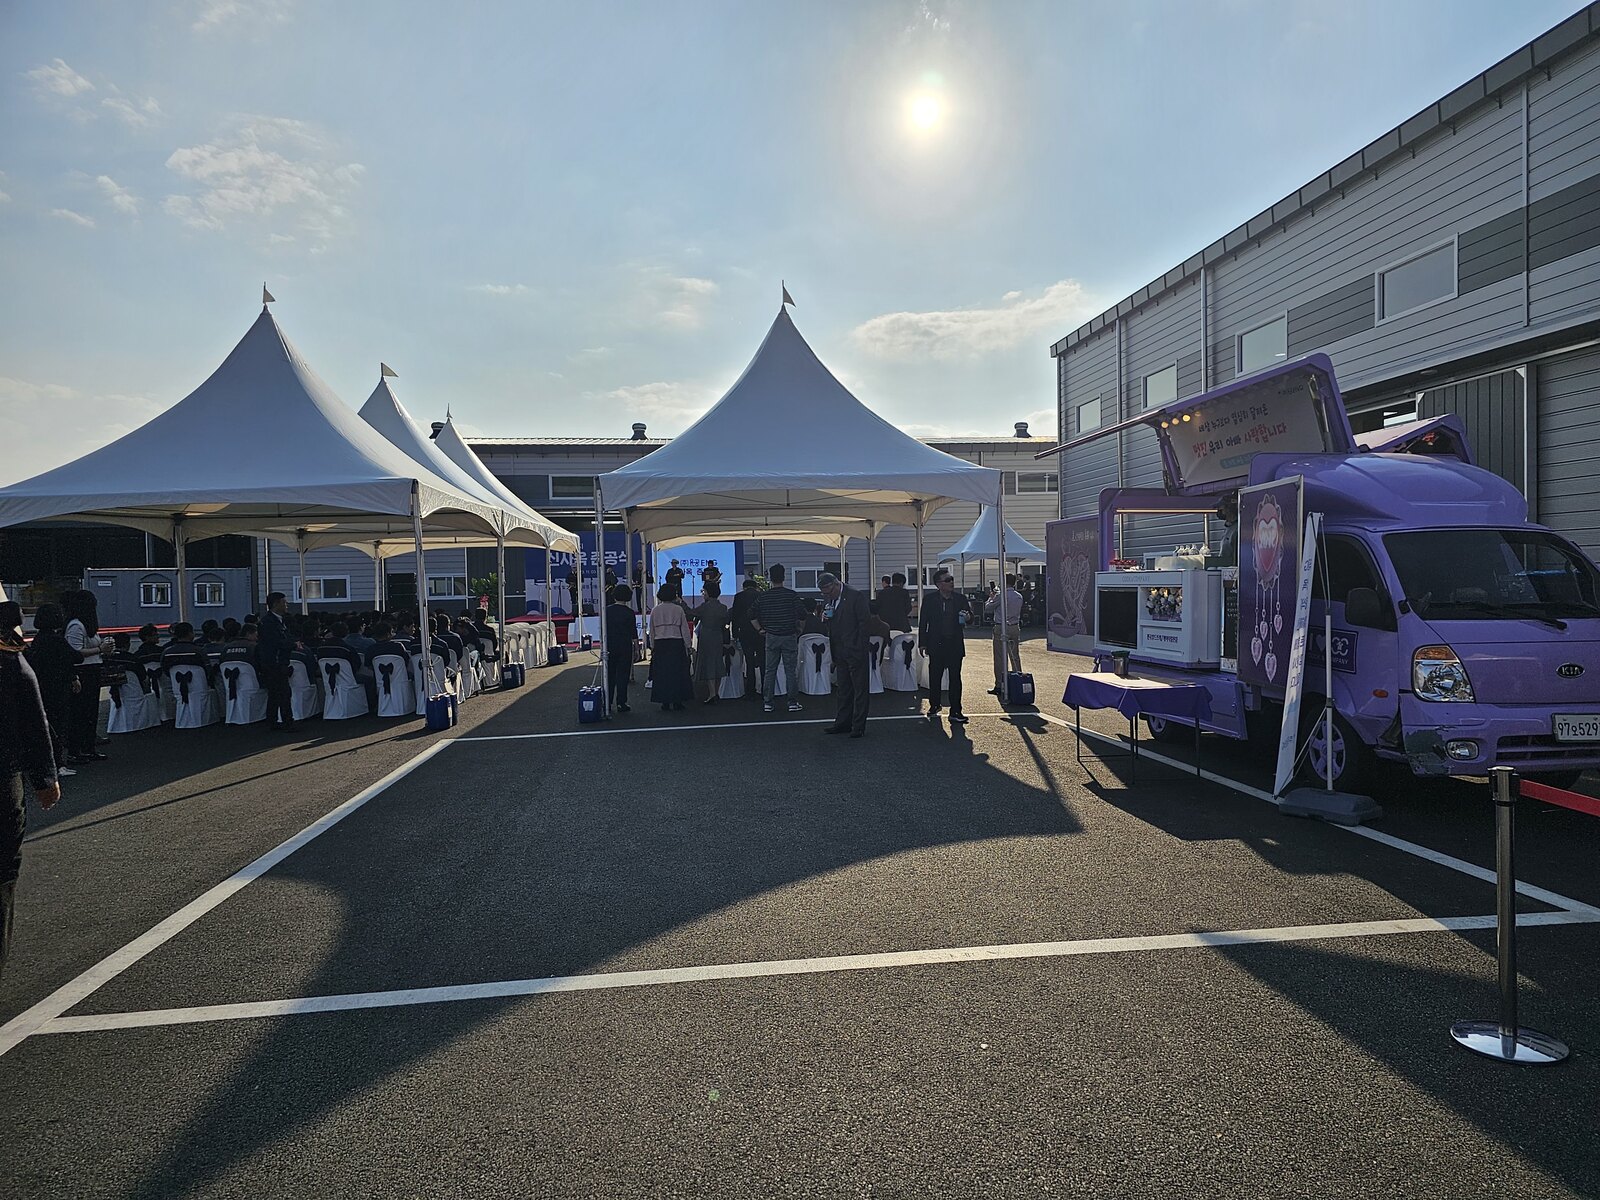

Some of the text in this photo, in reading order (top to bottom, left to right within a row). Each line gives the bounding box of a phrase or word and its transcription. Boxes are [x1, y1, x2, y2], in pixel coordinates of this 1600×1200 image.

[1231, 410, 1249, 425] 열심히
[1193, 422, 1287, 458] 멋진 우리 아빠 사랑합니다
[1562, 666, 1581, 675] KIA
[1558, 722, 1600, 736] 97오529
